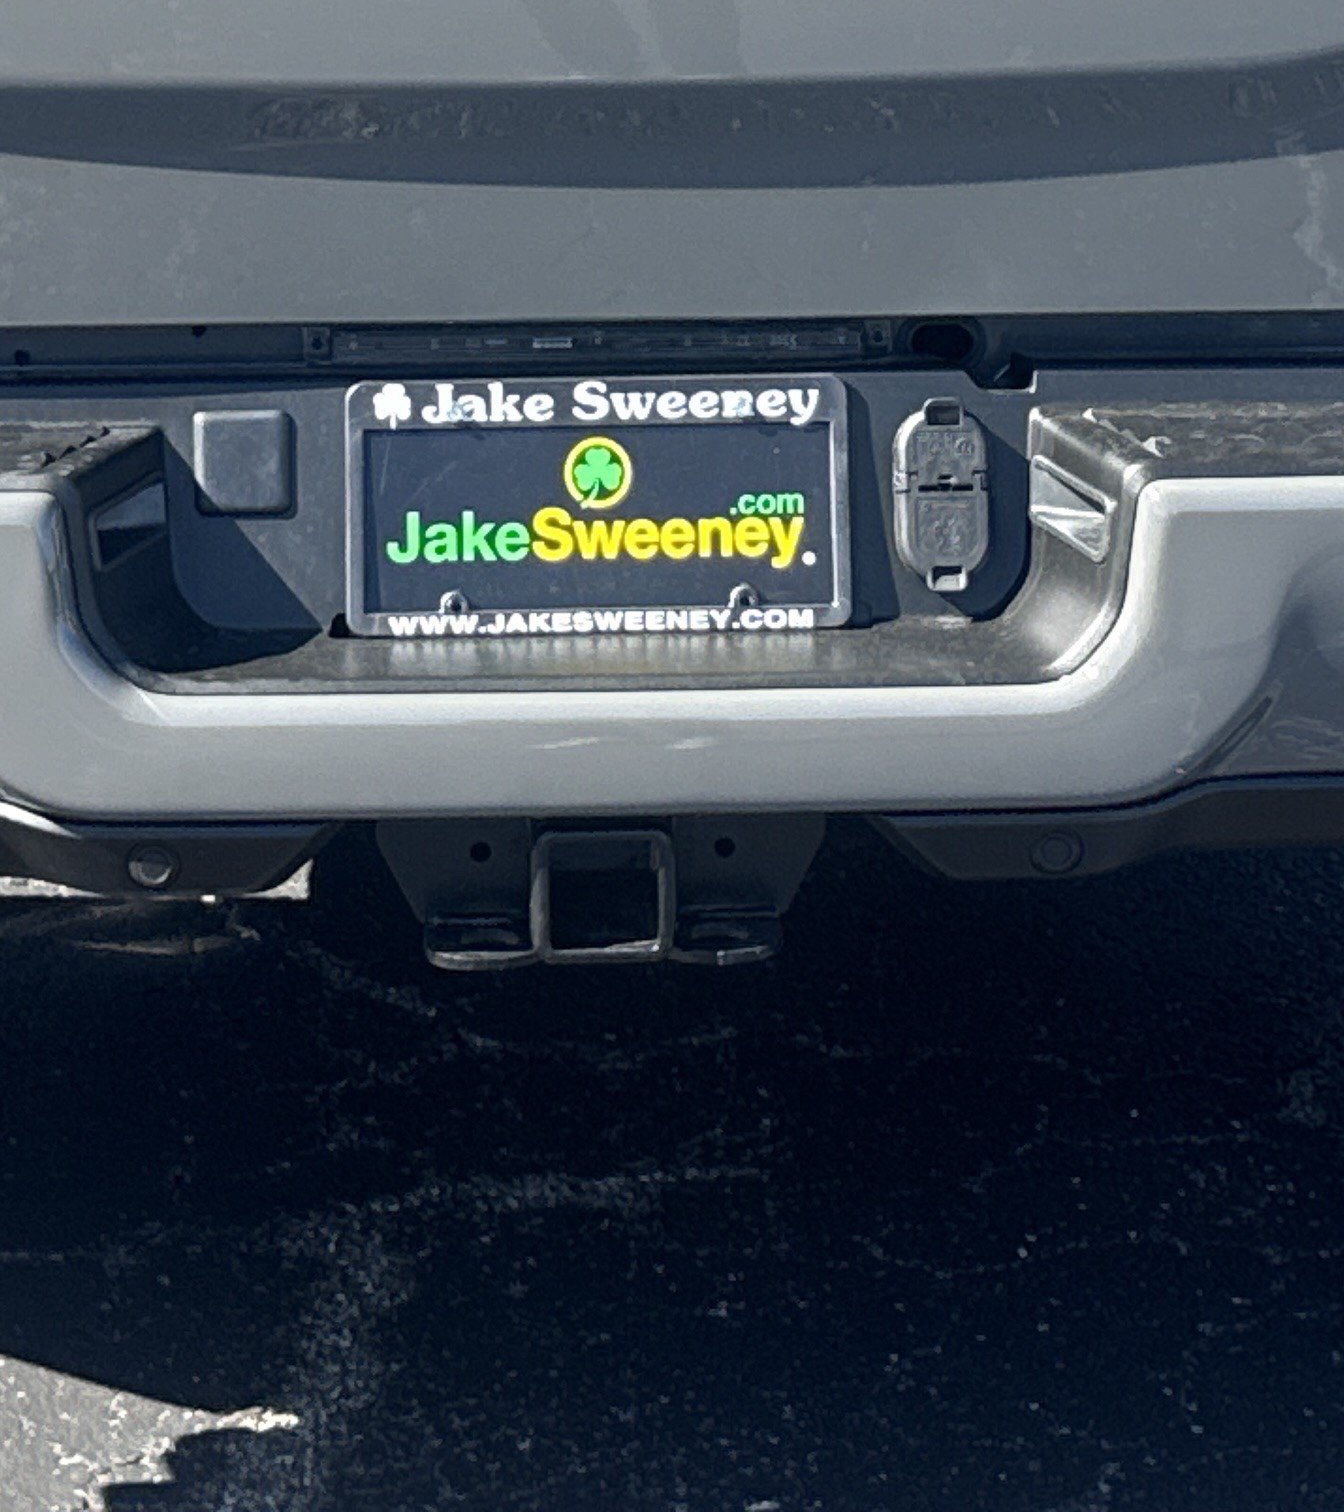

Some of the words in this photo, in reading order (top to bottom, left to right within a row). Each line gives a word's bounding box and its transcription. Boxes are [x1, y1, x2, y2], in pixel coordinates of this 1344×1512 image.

[421, 382, 555, 424] Jake
[572, 381, 819, 426] Sweeney
[729, 492, 804, 515] .com
[389, 609, 815, 636] WWW.JAKESWEENEY.COM
